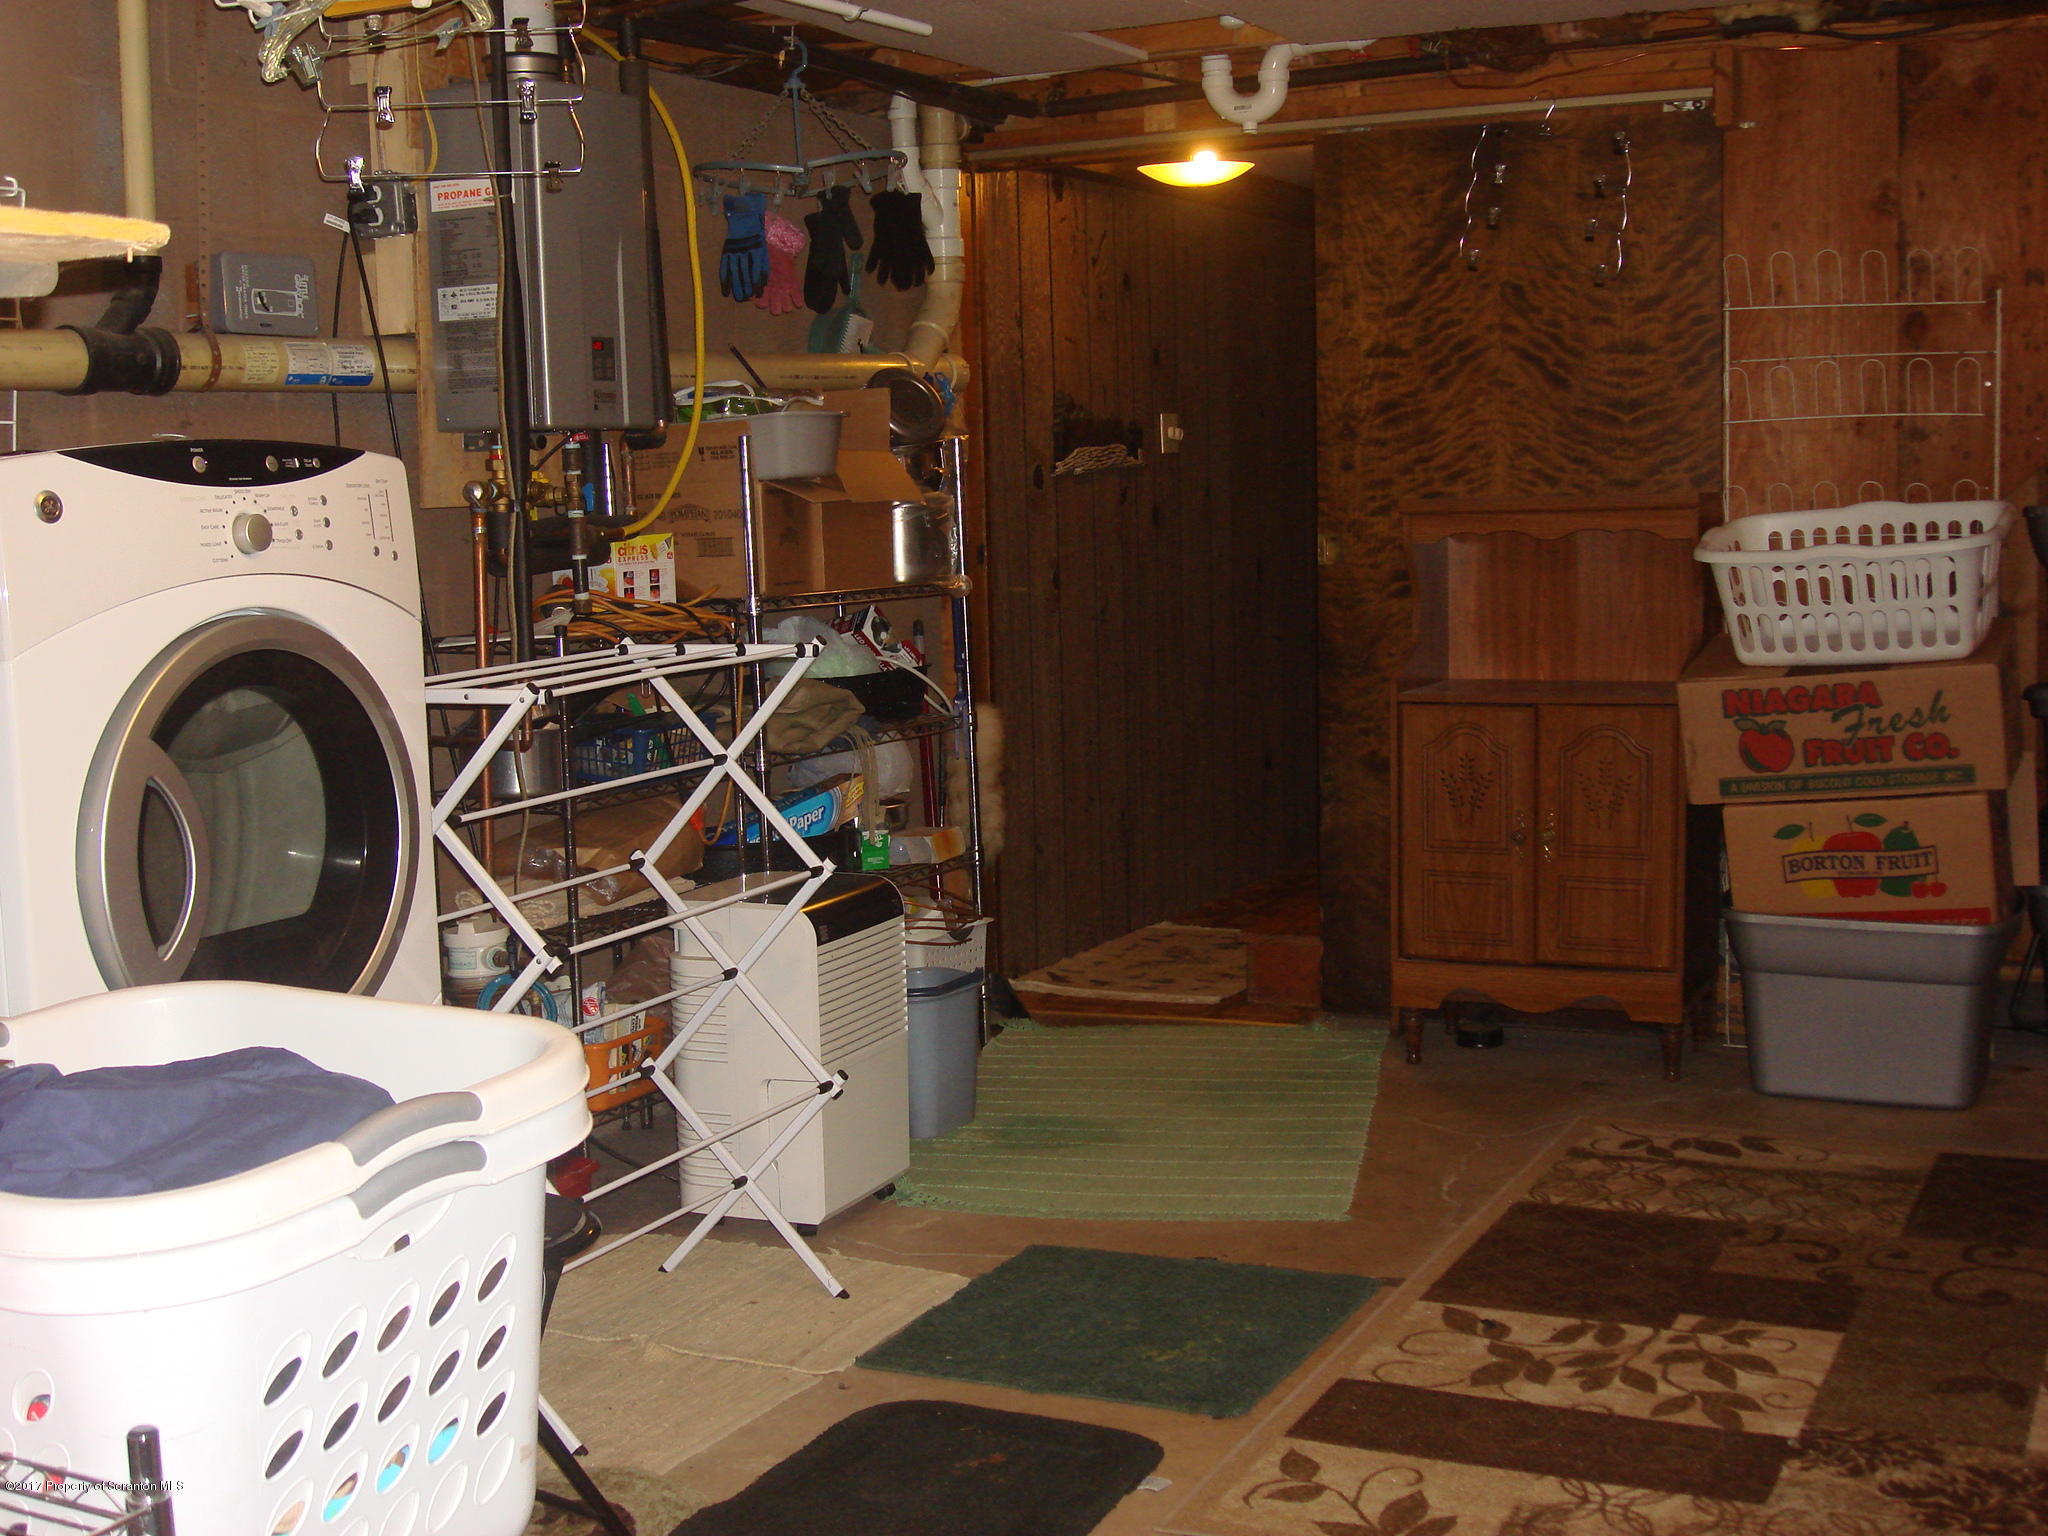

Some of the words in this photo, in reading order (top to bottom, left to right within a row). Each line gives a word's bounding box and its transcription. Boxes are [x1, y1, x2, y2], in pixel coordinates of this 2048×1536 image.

[437, 188, 481, 201] PROPANE
[1722, 680, 1884, 719] NIAGARA
[1832, 689, 1951, 745] Fresh
[1803, 734, 1896, 767] FRUIT
[1902, 731, 1961, 762] CO.
[789, 805, 826, 832] Paper
[1787, 855, 1865, 874] BORTON
[1875, 852, 1932, 871] FRUIT
